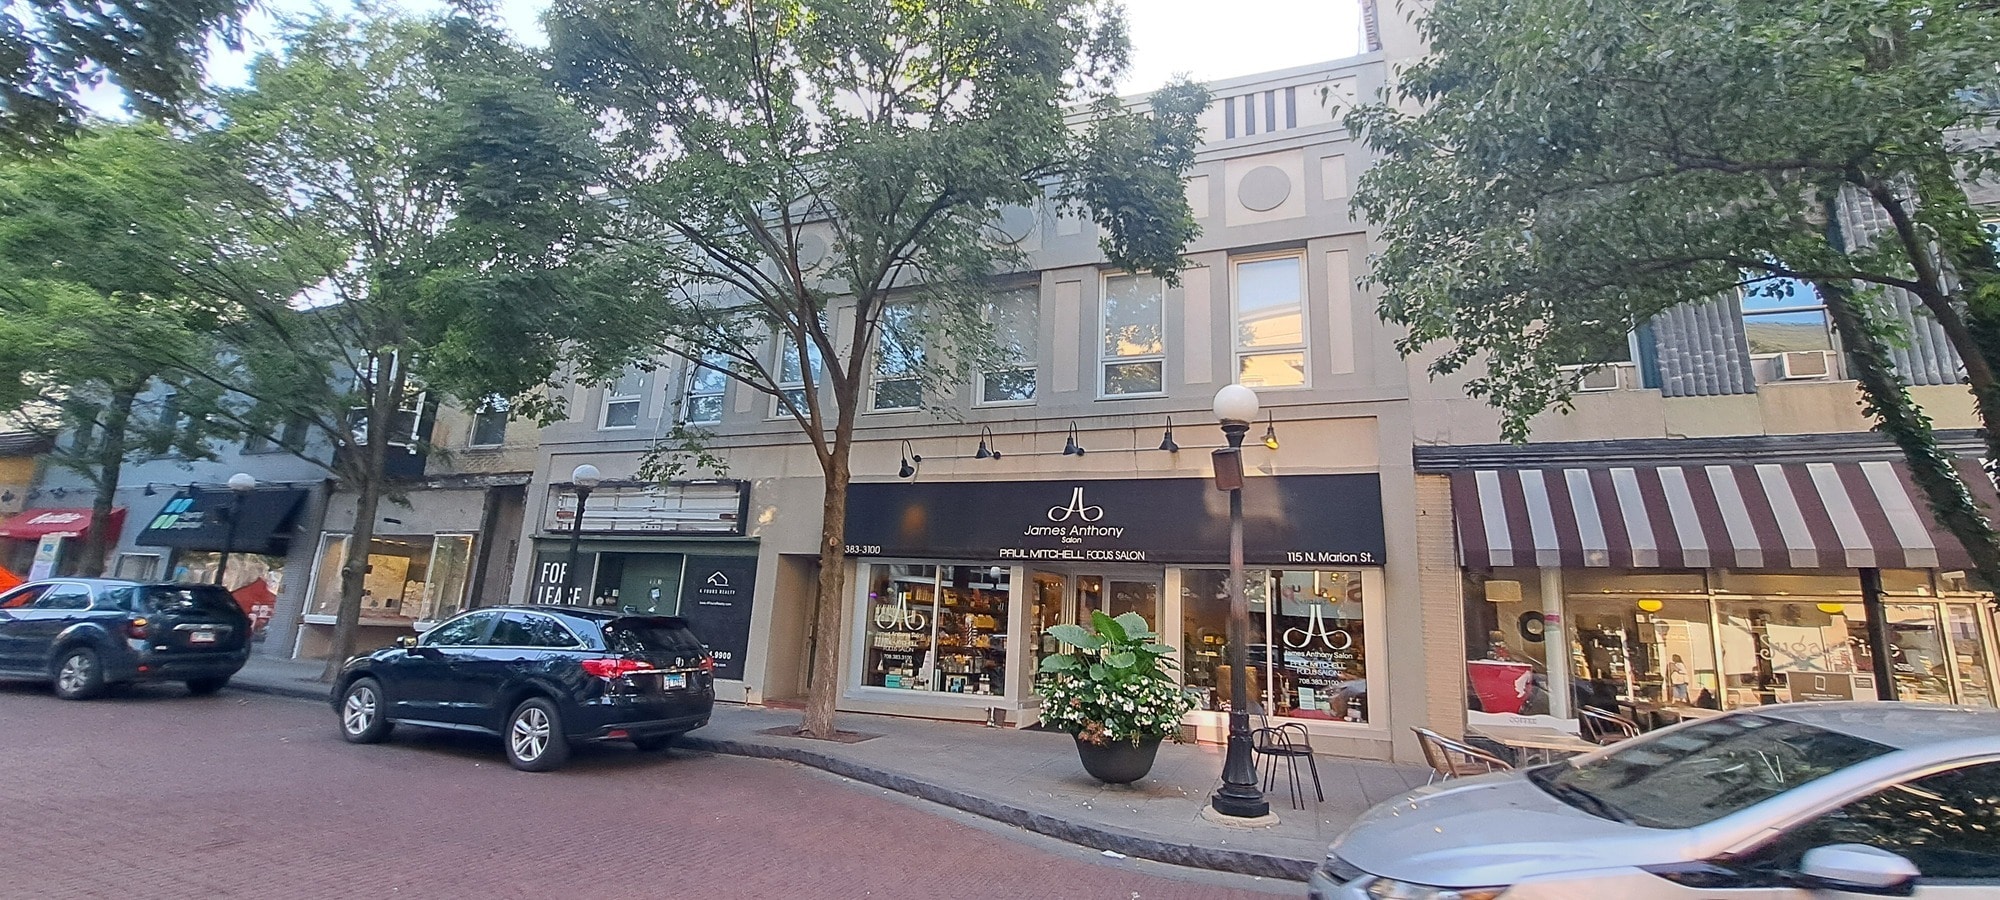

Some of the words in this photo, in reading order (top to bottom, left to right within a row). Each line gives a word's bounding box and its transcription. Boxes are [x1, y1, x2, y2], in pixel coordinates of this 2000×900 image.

[1023, 525, 1066, 536] James
[1069, 525, 1125, 539] Anthony
[1061, 536, 1082, 544] Salon
[844, 544, 881, 555] 383-3100
[999, 548, 1028, 558] PAUL
[1029, 549, 1084, 560] MITCHELL
[1086, 550, 1113, 560] FOCUS
[1114, 550, 1145, 561] SALON
[1287, 551, 1303, 562] 115
[1304, 551, 1317, 562] N.
[1318, 551, 1358, 563] Marion
[1360, 551, 1375, 563] St.
[1305, 650, 1333, 661] Anthony
[1333, 651, 1353, 660] Salon
